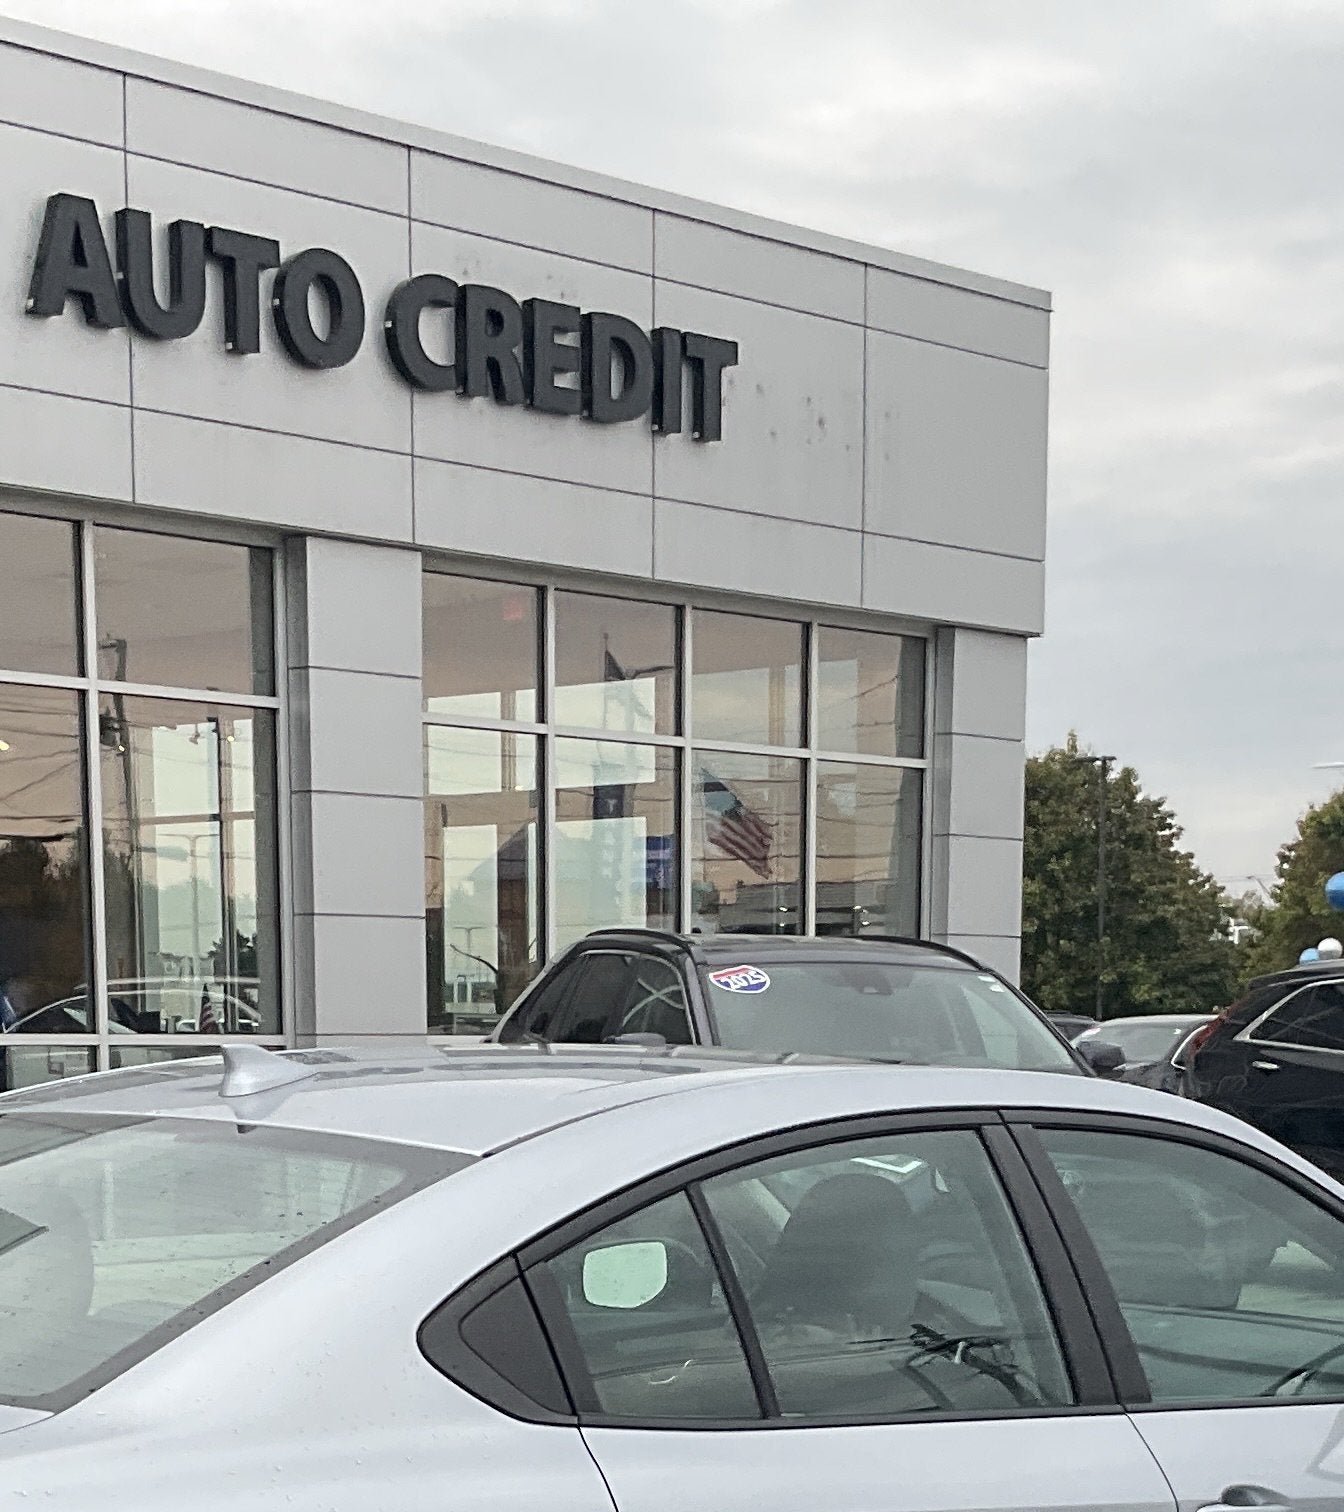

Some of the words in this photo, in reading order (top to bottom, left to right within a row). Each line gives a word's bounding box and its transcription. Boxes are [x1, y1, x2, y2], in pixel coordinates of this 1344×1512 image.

[26, 193, 365, 369] AUTO
[385, 274, 739, 442] CREDIT
[719, 971, 767, 989] 2025
